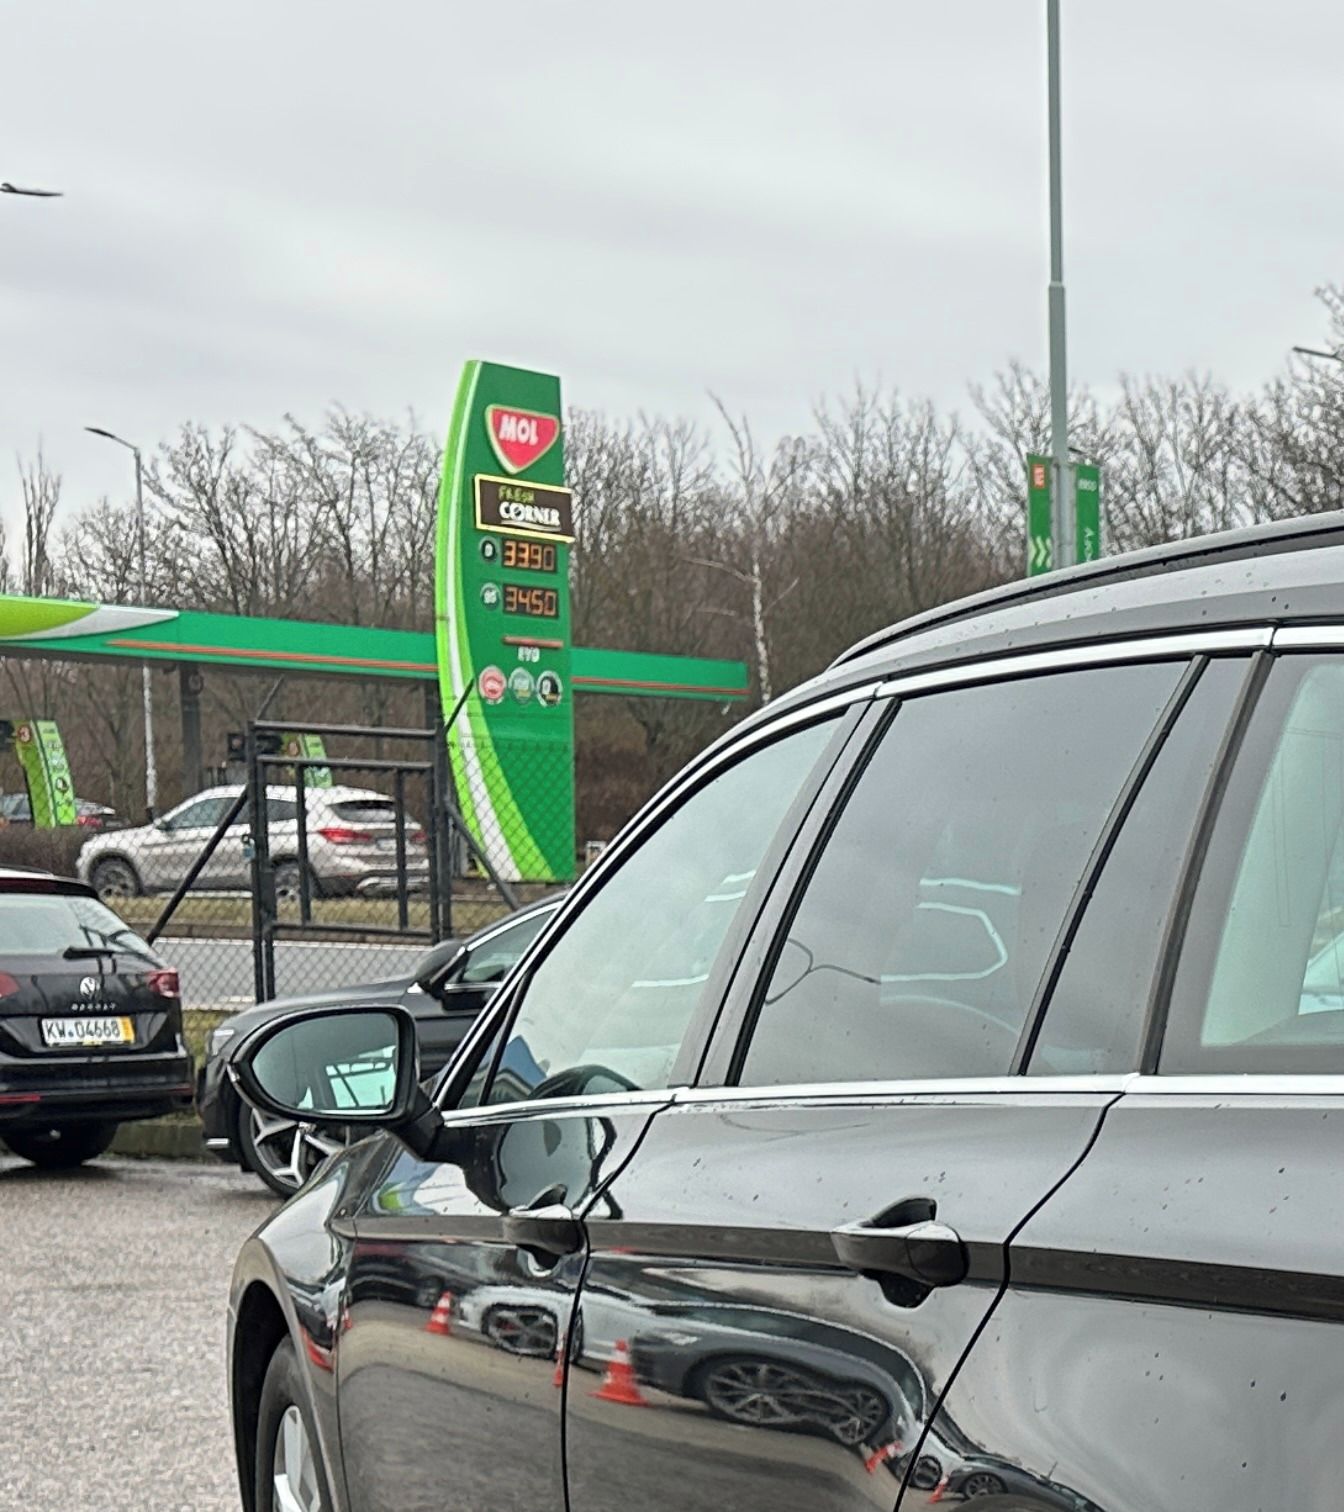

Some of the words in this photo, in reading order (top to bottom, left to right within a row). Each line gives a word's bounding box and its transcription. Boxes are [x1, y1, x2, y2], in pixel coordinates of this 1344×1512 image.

[499, 413, 539, 446] MOL
[498, 486, 535, 503] FRESH
[499, 501, 561, 526] CORNER
